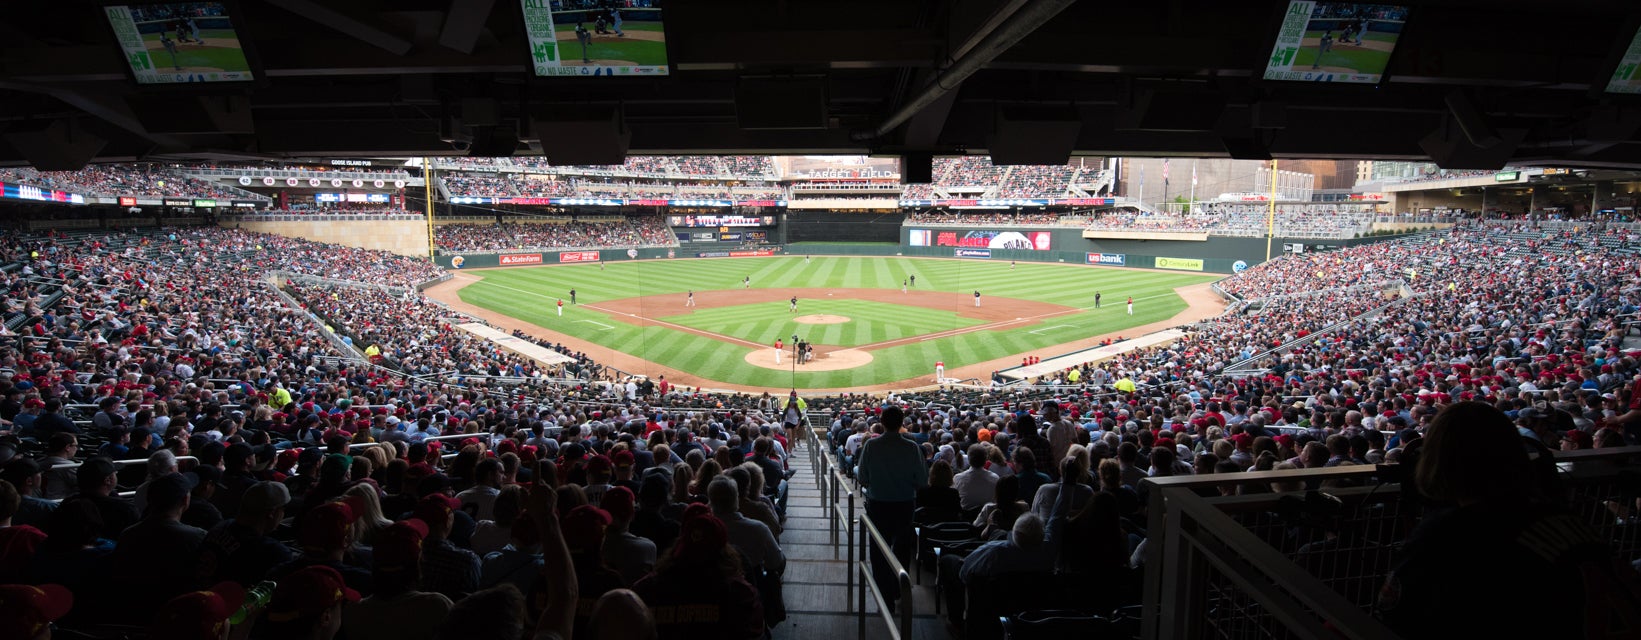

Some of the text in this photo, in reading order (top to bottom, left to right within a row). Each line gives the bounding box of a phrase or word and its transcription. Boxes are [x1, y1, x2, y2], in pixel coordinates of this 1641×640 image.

[109, 8, 130, 19] ALL
[1290, 2, 1309, 15] ALL
[548, 67, 577, 75] NO WASTE
[937, 237, 990, 248] POLANCO
[1003, 239, 1031, 249] POLANCO
[1169, 260, 1198, 268] CenturyLink
